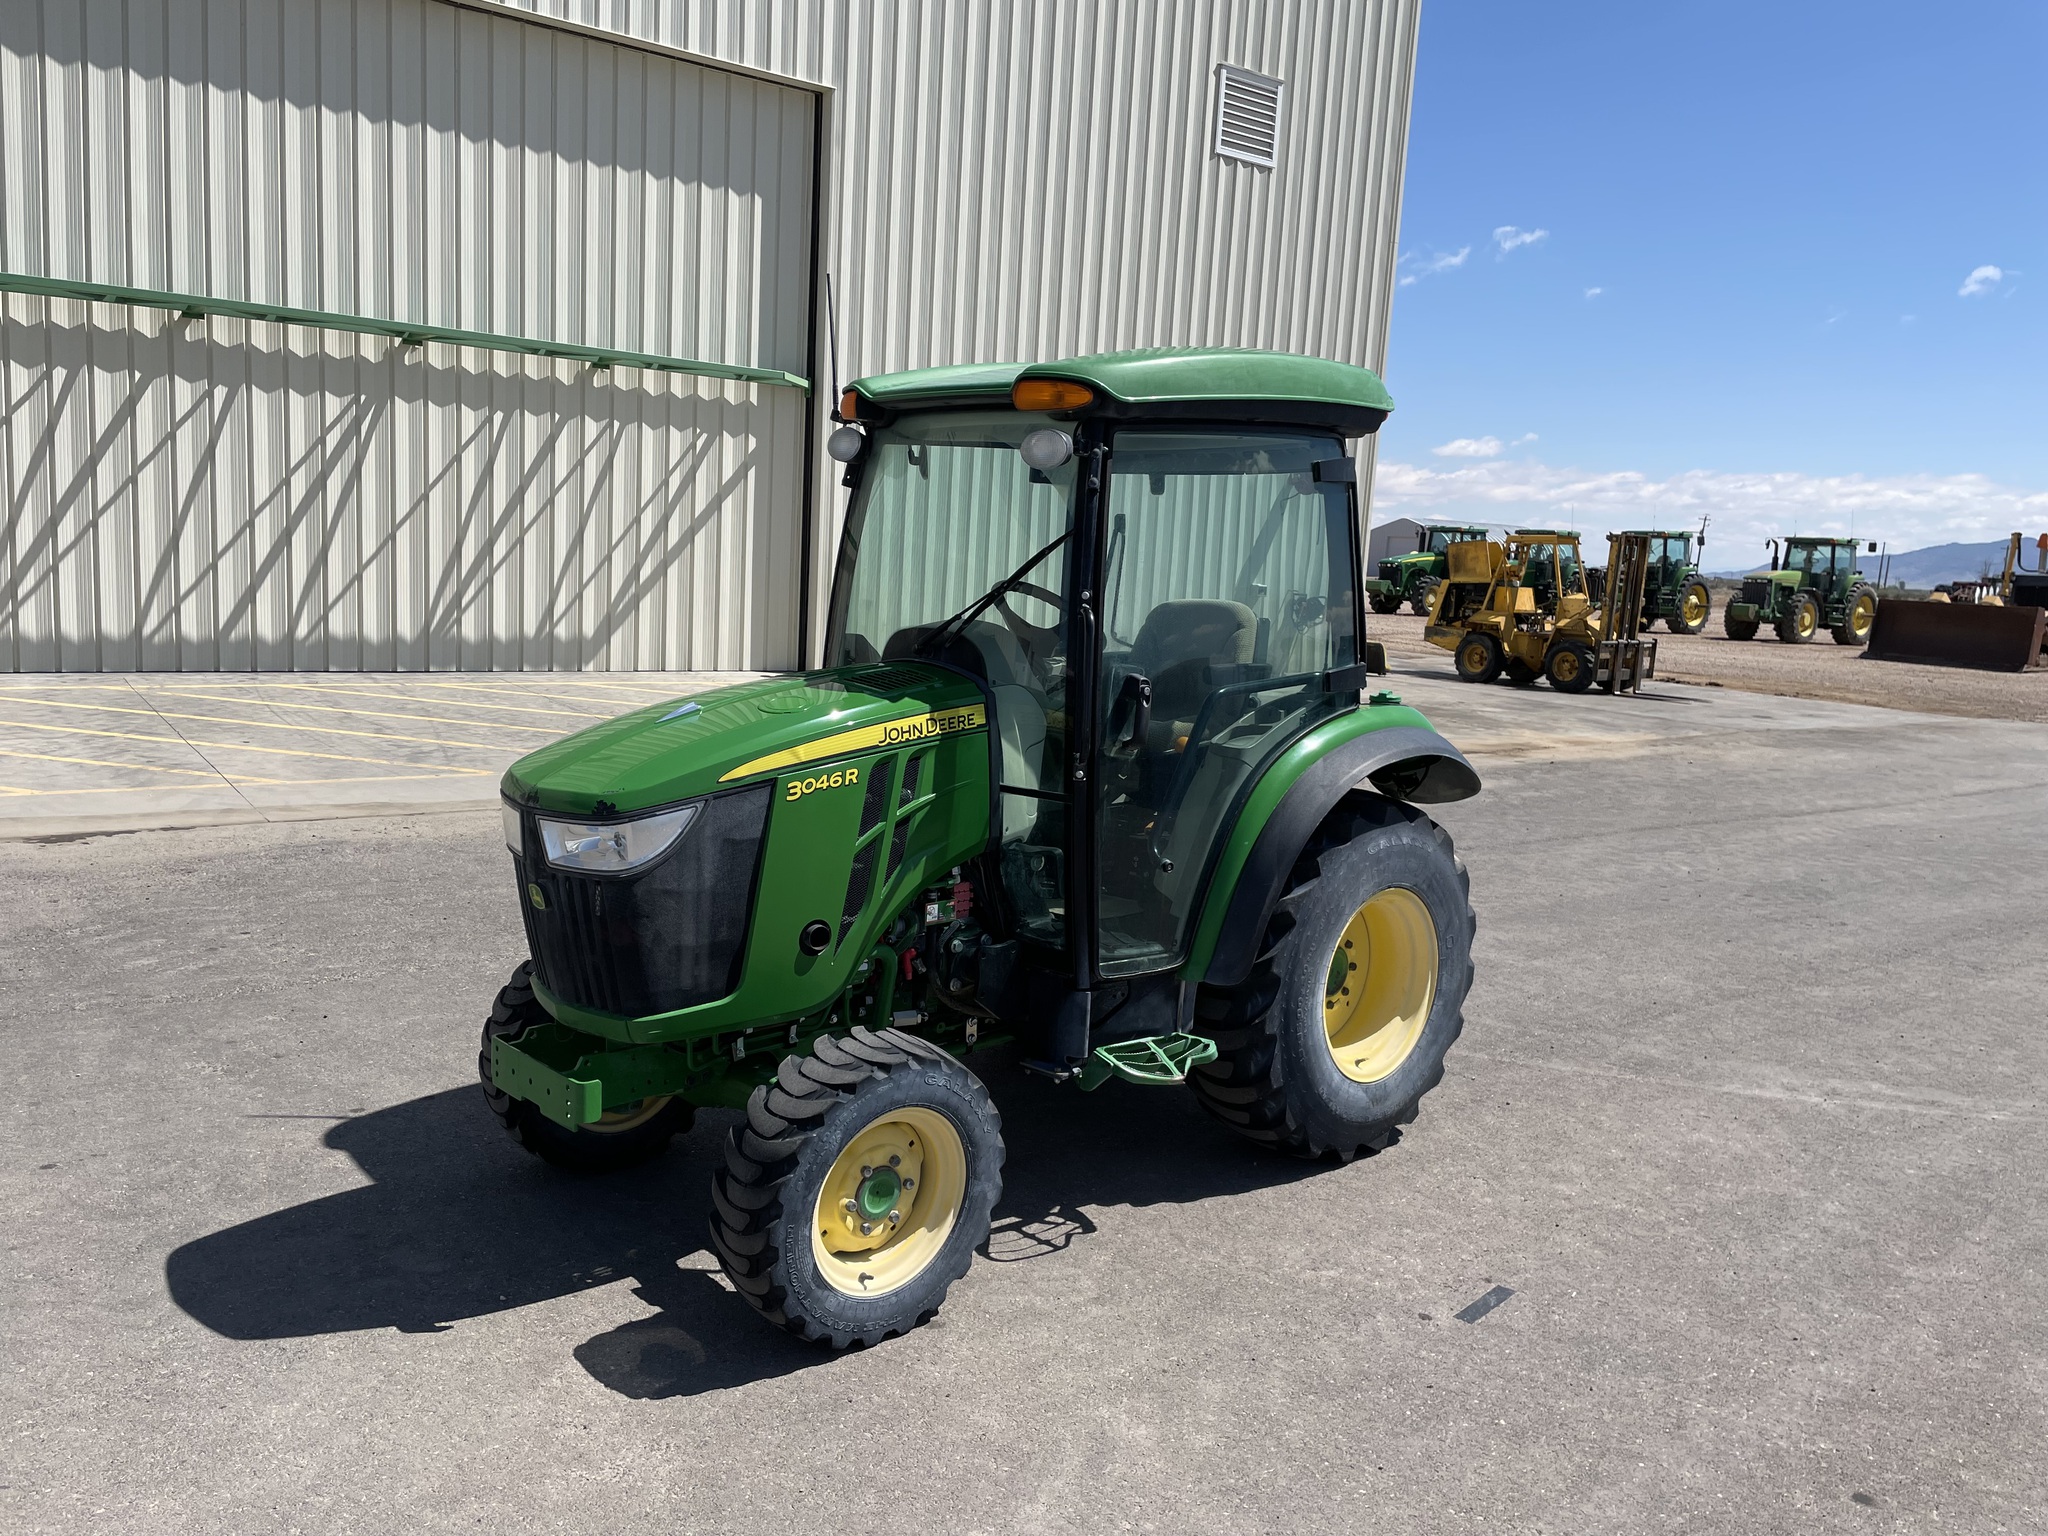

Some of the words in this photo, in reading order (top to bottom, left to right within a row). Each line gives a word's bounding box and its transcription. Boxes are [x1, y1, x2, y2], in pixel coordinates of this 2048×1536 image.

[878, 722, 924, 745] JOHN
[925, 713, 976, 734] DEERE
[924, 1073, 993, 1134] GALAXY
